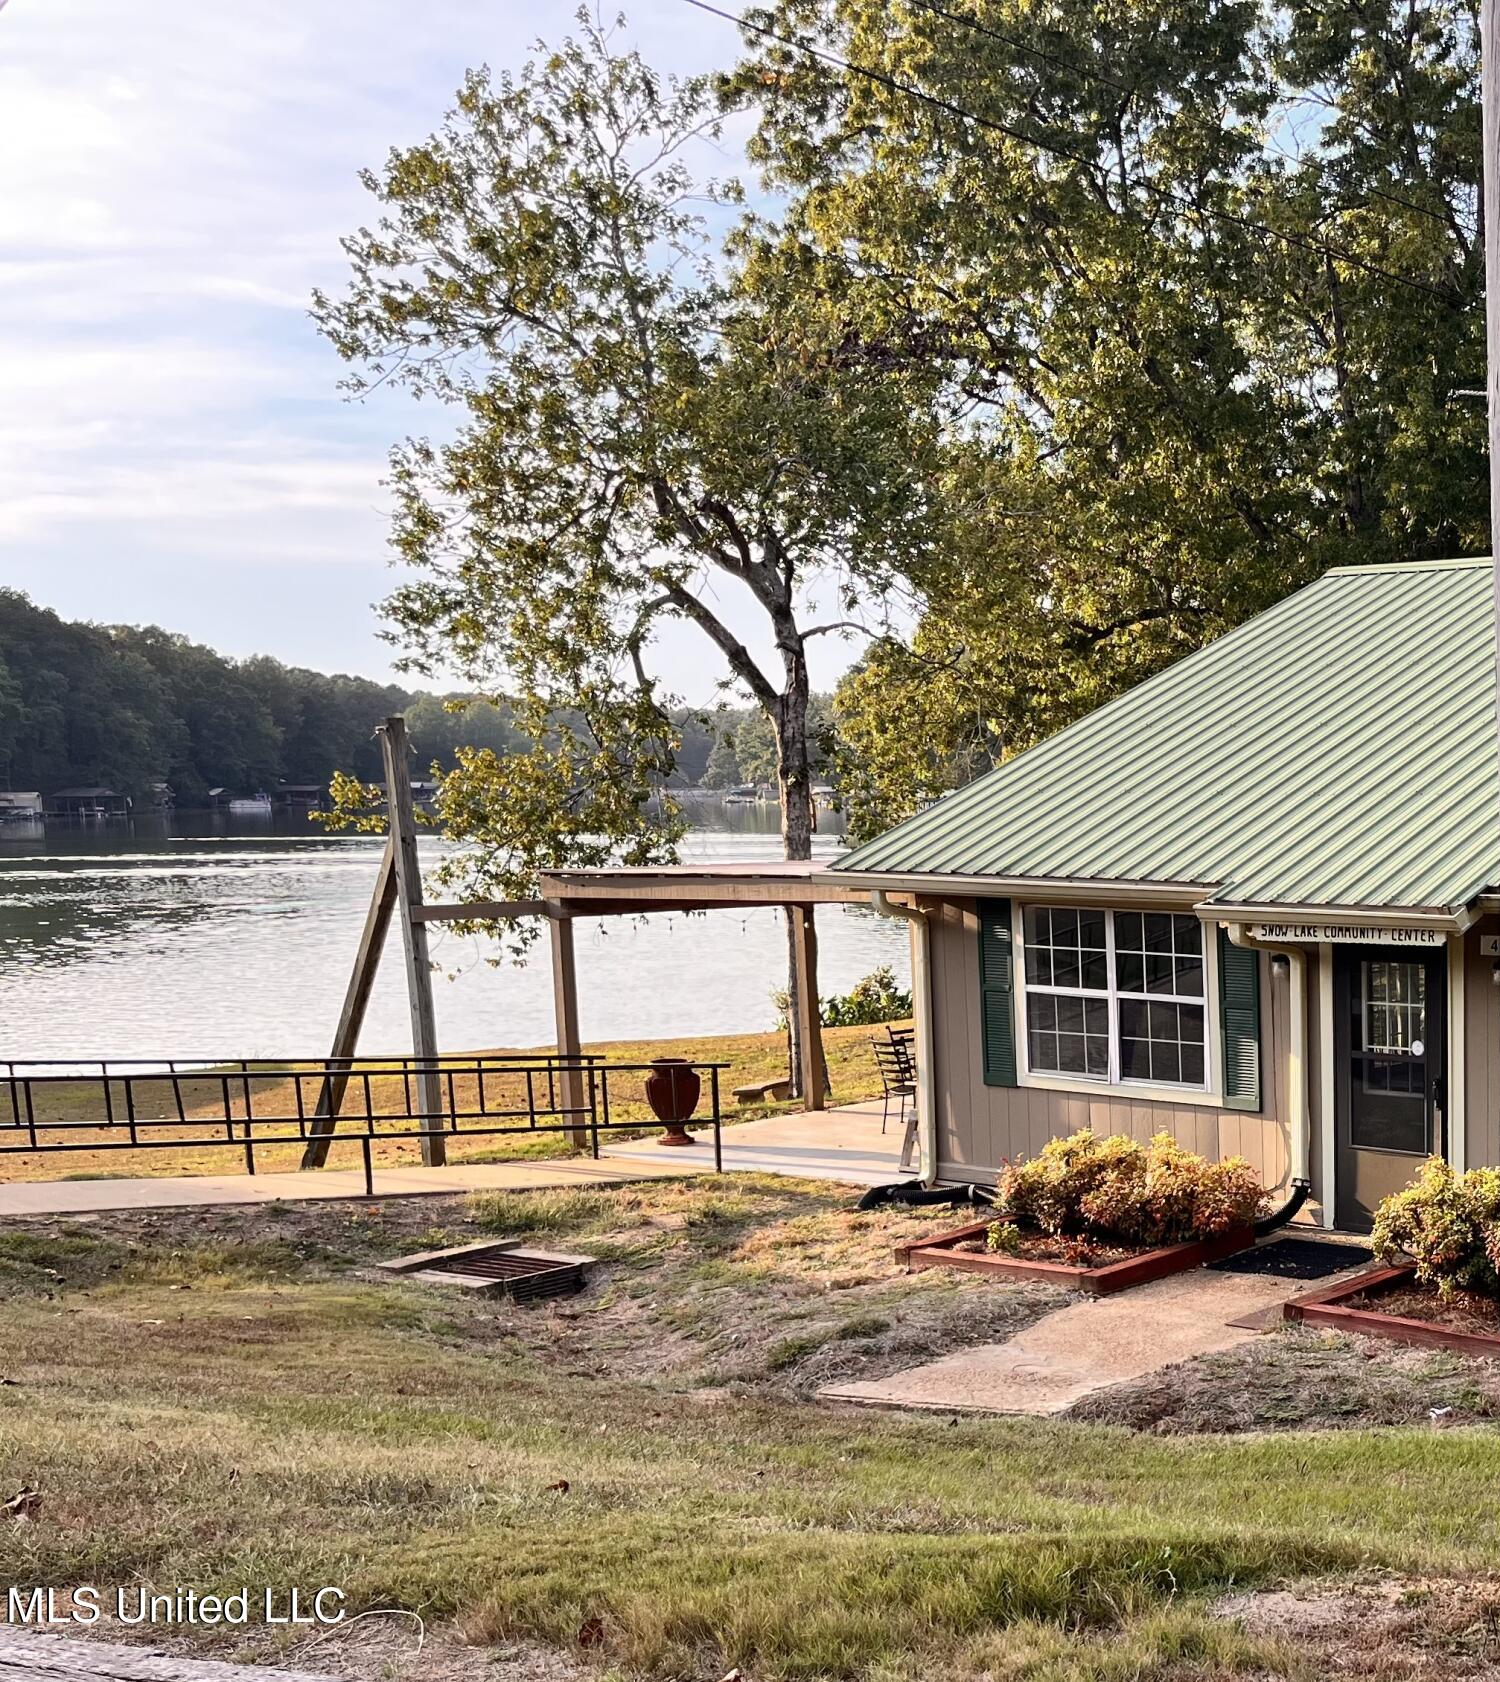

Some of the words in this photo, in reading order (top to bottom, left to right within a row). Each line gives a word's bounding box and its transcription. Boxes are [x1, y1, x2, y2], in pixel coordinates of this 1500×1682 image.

[1261, 924, 1288, 937] SNOW
[1294, 925, 1318, 938] LAKE
[1324, 926, 1383, 940] COMMUNITY
[1391, 928, 1435, 943] CENTER
